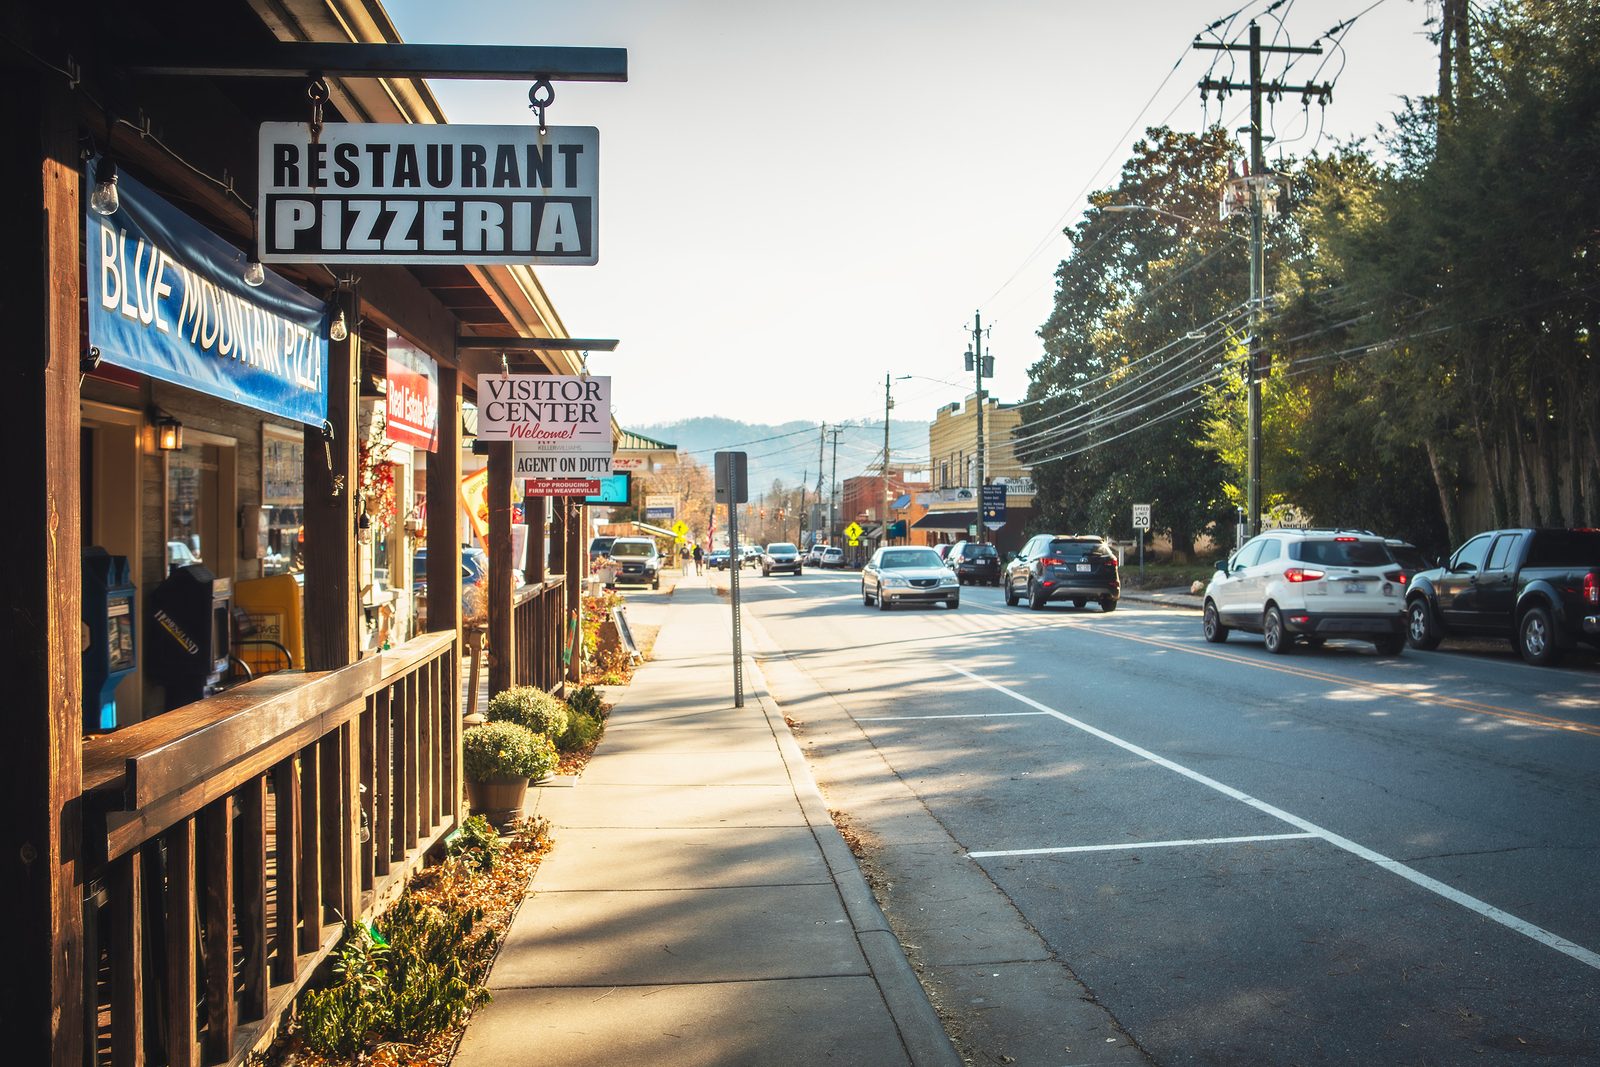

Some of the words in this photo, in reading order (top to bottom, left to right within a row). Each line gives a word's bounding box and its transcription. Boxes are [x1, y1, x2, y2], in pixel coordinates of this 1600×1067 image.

[273, 143, 584, 189] RESTAURANT
[274, 199, 582, 252] PIZZERIA
[101, 224, 174, 333] BLUE
[177, 266, 282, 376] MOUNTAIN
[284, 319, 322, 393] PIZZA
[485, 379, 603, 401] VISITOR
[389, 379, 404, 419] Real
[405, 387, 423, 427] Estate
[485, 401, 599, 423] CENTER
[509, 422, 578, 440] Welcome!
[517, 457, 557, 473] AGENT
[560, 457, 579, 473] ON
[580, 457, 611, 473] DUTY
[1134, 516, 1149, 526] 20
